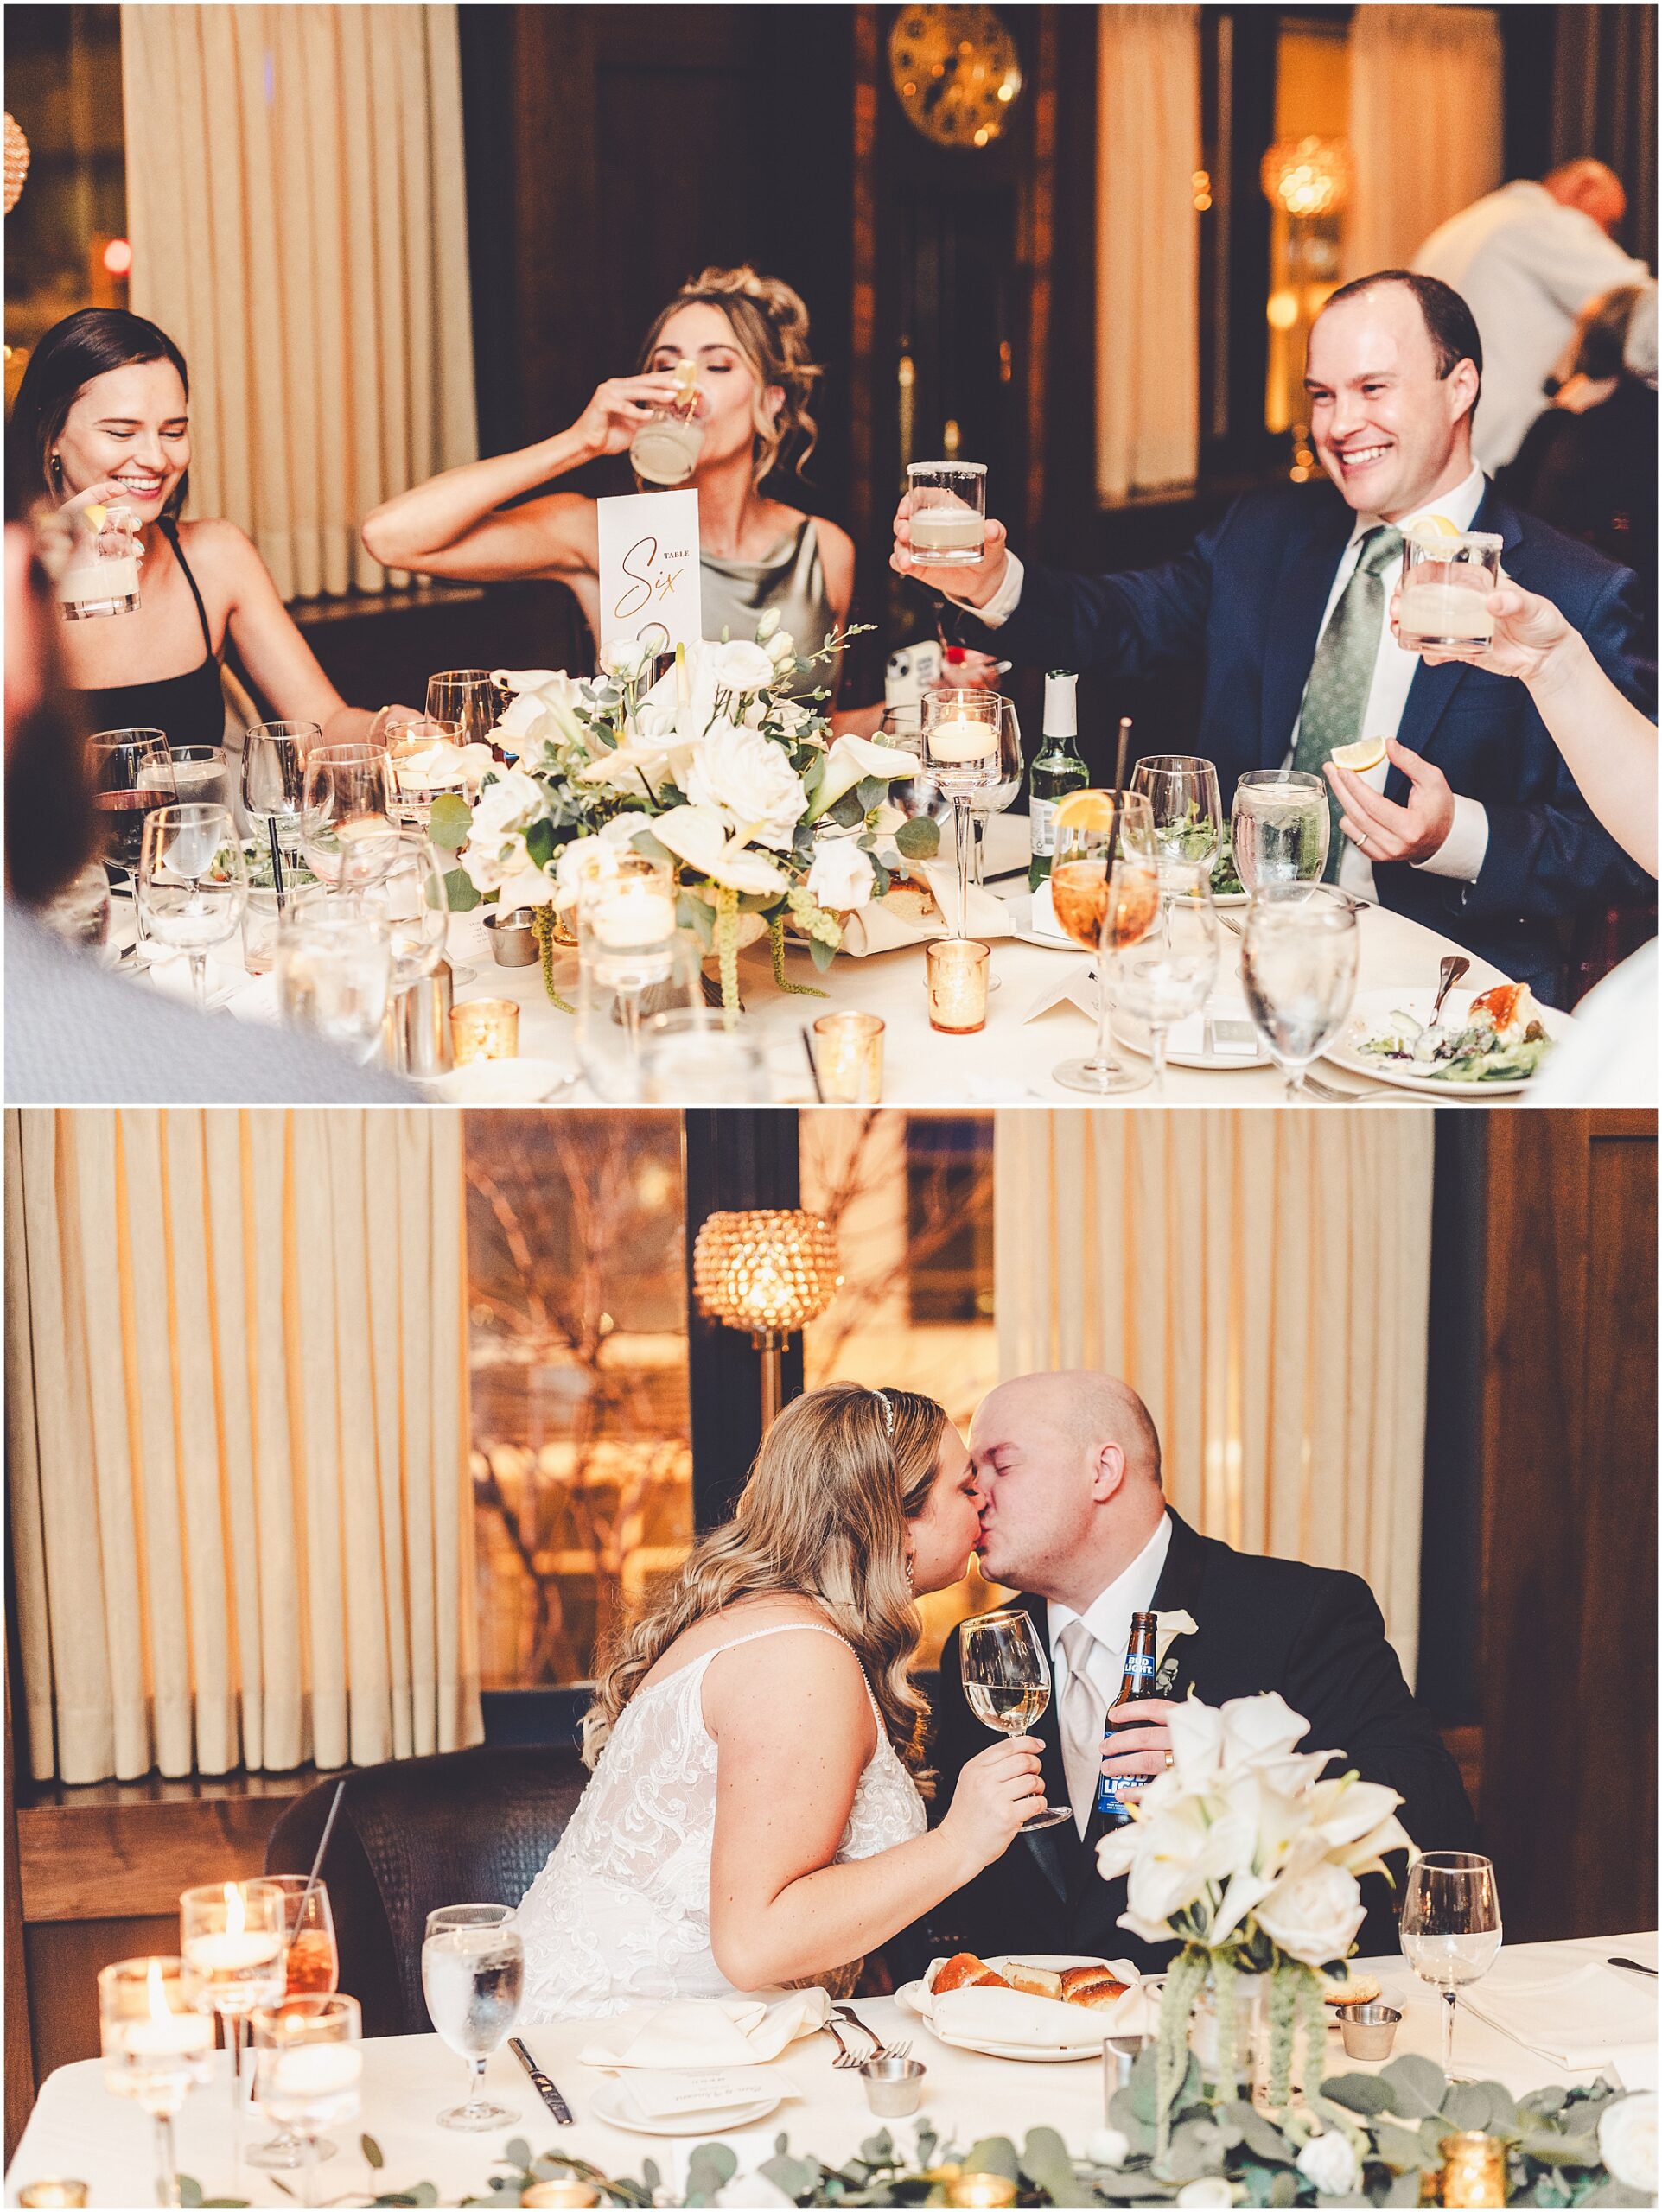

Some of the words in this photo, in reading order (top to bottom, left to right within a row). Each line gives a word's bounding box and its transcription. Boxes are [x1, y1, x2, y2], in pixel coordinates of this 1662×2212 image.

[664, 550, 690, 559] TABLE
[614, 537, 685, 619] Six
[1128, 1656, 1149, 1666] BUD
[1124, 1664, 1153, 1674] LIGHT
